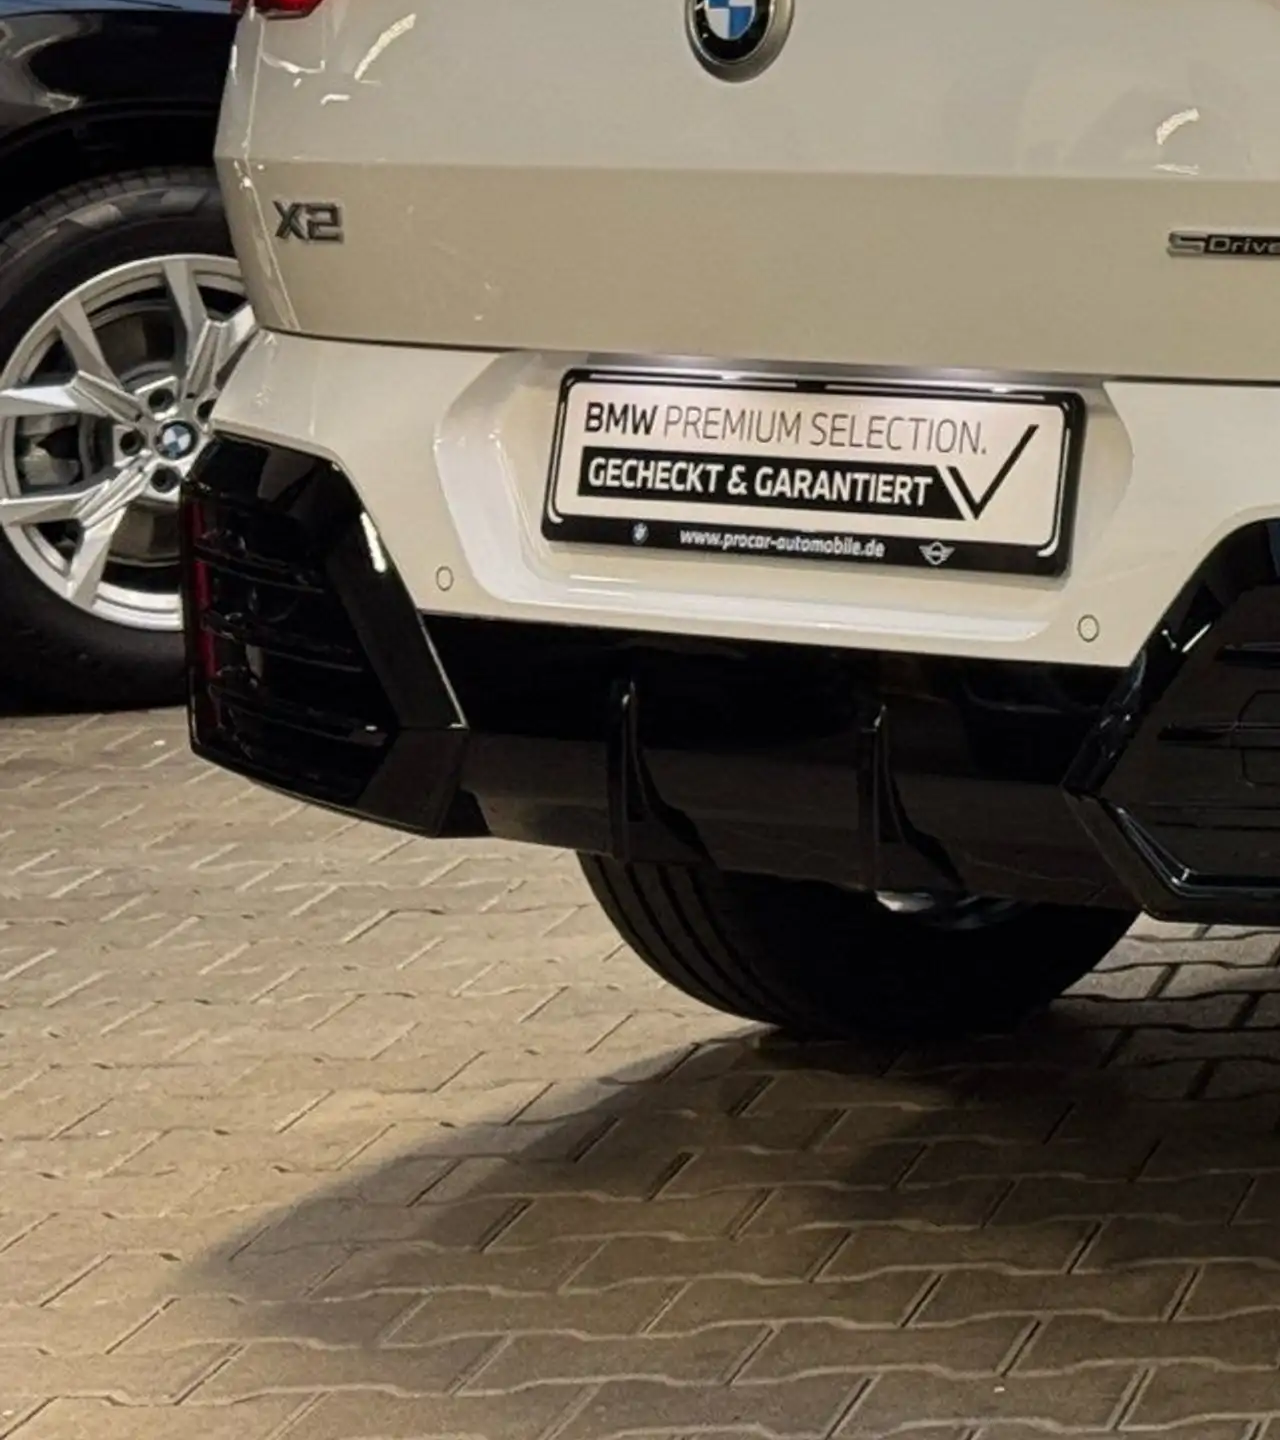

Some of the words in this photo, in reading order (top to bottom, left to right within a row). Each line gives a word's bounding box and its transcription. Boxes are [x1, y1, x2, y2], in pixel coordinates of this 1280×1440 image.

[272, 200, 344, 244] X2
[584, 401, 659, 436] BMW
[663, 405, 802, 445] PREMIUM
[809, 411, 988, 455] SELECTION.
[587, 457, 725, 494] GECHECKT
[726, 464, 748, 496] &
[754, 466, 933, 506] GARANTIERT
[679, 528, 886, 558] www.procar-automobile.de
